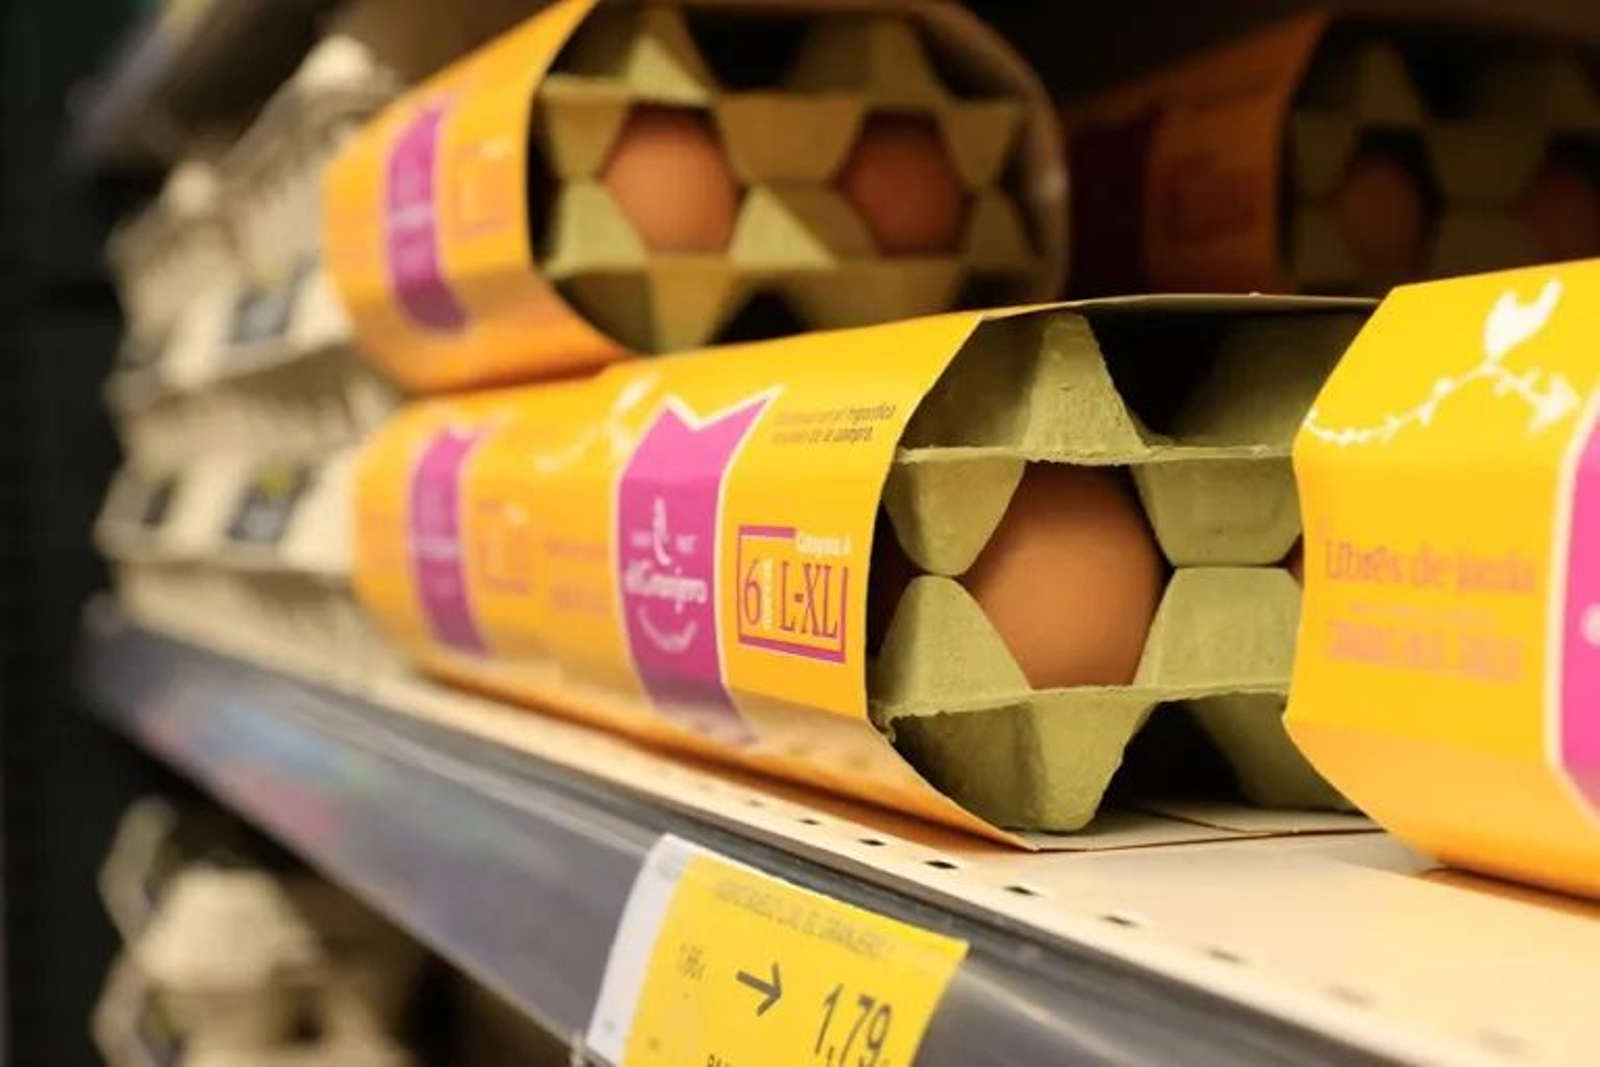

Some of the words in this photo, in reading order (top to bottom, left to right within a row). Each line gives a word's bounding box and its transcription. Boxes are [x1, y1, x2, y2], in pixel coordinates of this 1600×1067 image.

[744, 557, 762, 626] 6
[779, 560, 838, 638] L-XL
[814, 982, 893, 1067] 1,79
